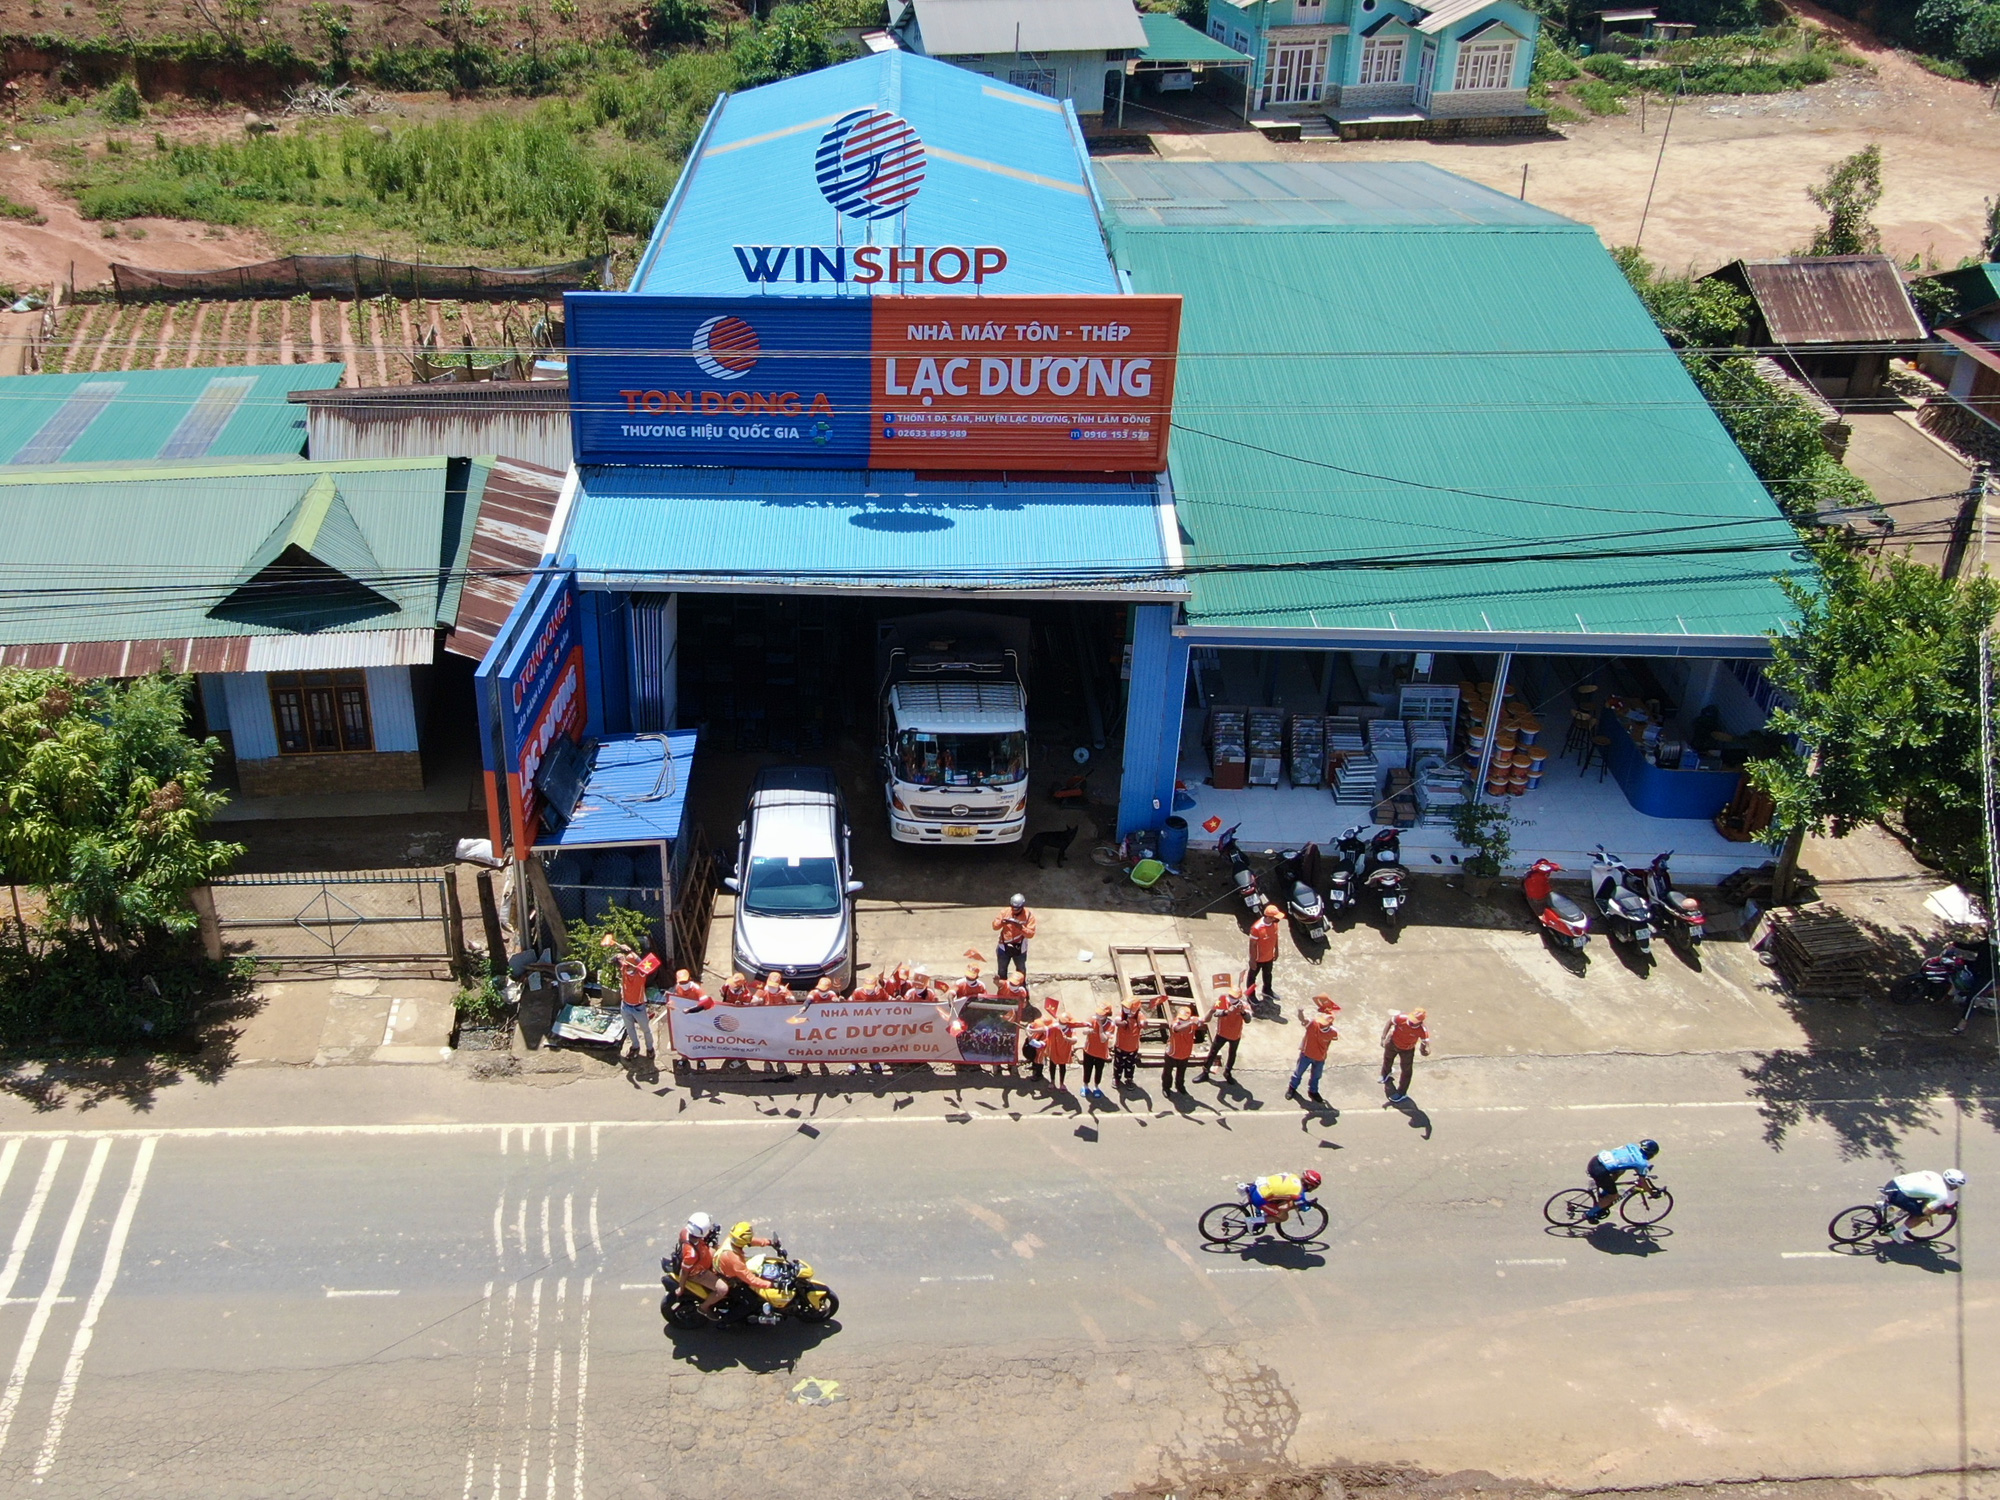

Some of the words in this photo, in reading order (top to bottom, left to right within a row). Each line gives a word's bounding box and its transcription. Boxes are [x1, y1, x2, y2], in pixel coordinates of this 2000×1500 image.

[733, 244, 1008, 284] WINSHOP
[907, 321, 953, 341] NHÀ
[961, 321, 1007, 341] MÁY
[1014, 321, 1059, 341] TÔN
[1079, 321, 1131, 342] THÉP
[885, 358, 970, 406] LẠC
[979, 356, 1151, 397] DƯƠNG
[619, 390, 693, 415] TON
[700, 391, 801, 417] DONG
[807, 392, 835, 418] A
[898, 413, 925, 422] THÔN
[975, 414, 1007, 425] HUYỆN
[1010, 415, 1028, 425] LẠC
[1098, 414, 1119, 423] LÂM
[621, 424, 686, 438] THƯƠNG
[691, 424, 723, 440] HIỆU
[728, 424, 770, 440] QUỐC
[774, 427, 800, 439] GIA
[898, 429, 927, 437] 02633
[930, 429, 947, 437] 889
[950, 430, 967, 438] 989
[820, 1007, 849, 1018] NHÀ
[853, 1006, 882, 1016] MÁY
[885, 1006, 913, 1015] TÔN
[685, 1034, 713, 1043] TON
[716, 1035, 755, 1045] DONG
[795, 1027, 838, 1044] LẠC
[846, 1021, 934, 1039] DƯƠNG
[788, 1047, 823, 1056] CHÀO
[827, 1046, 868, 1056] MỪNG
[872, 1043, 909, 1054] ĐOÀN
[913, 1043, 940, 1053] ĐUA
